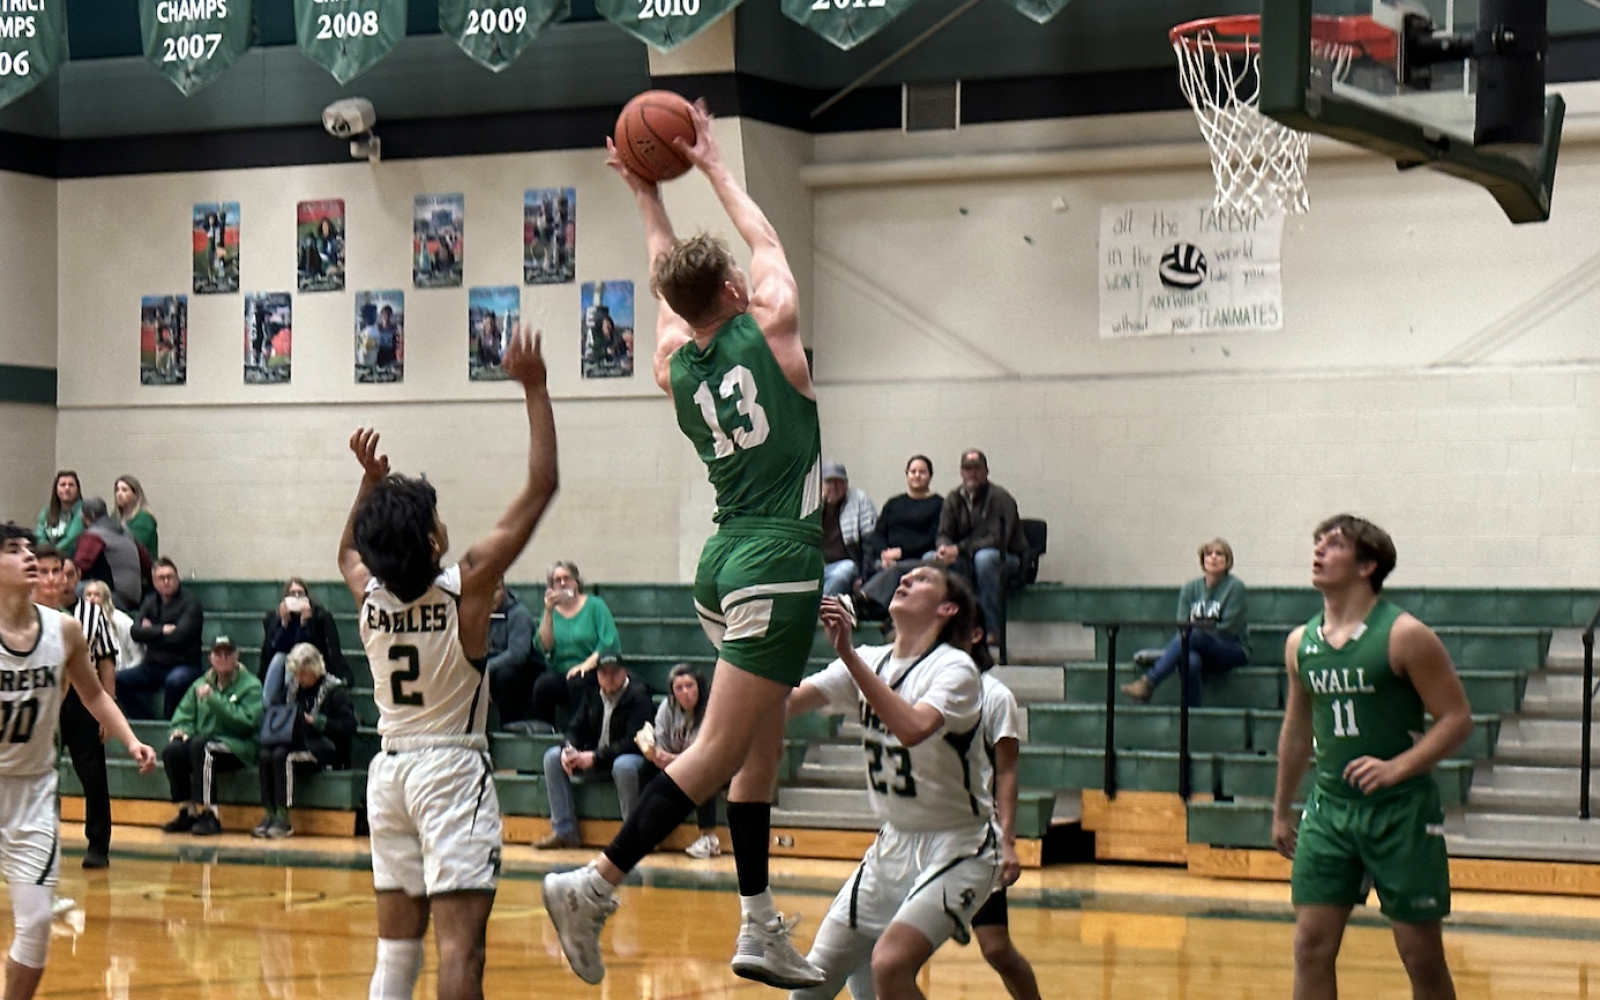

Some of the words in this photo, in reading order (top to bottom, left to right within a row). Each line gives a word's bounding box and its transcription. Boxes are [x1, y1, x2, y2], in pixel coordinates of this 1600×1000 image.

[156, 0, 227, 23] CHAMPS
[317, 10, 379, 39] 2008
[466, 6, 526, 35] 2009
[163, 33, 222, 62] 2007
[1112, 209, 1133, 235] all
[1107, 247, 1123, 267] in
[1199, 305, 1279, 329] TEAMMATES
[693, 364, 771, 459] 13
[366, 602, 447, 634] EAGLES
[388, 645, 425, 707] 2
[1308, 667, 1376, 694] WALL
[1331, 698, 1360, 737] 11
[864, 739, 917, 798] 23
